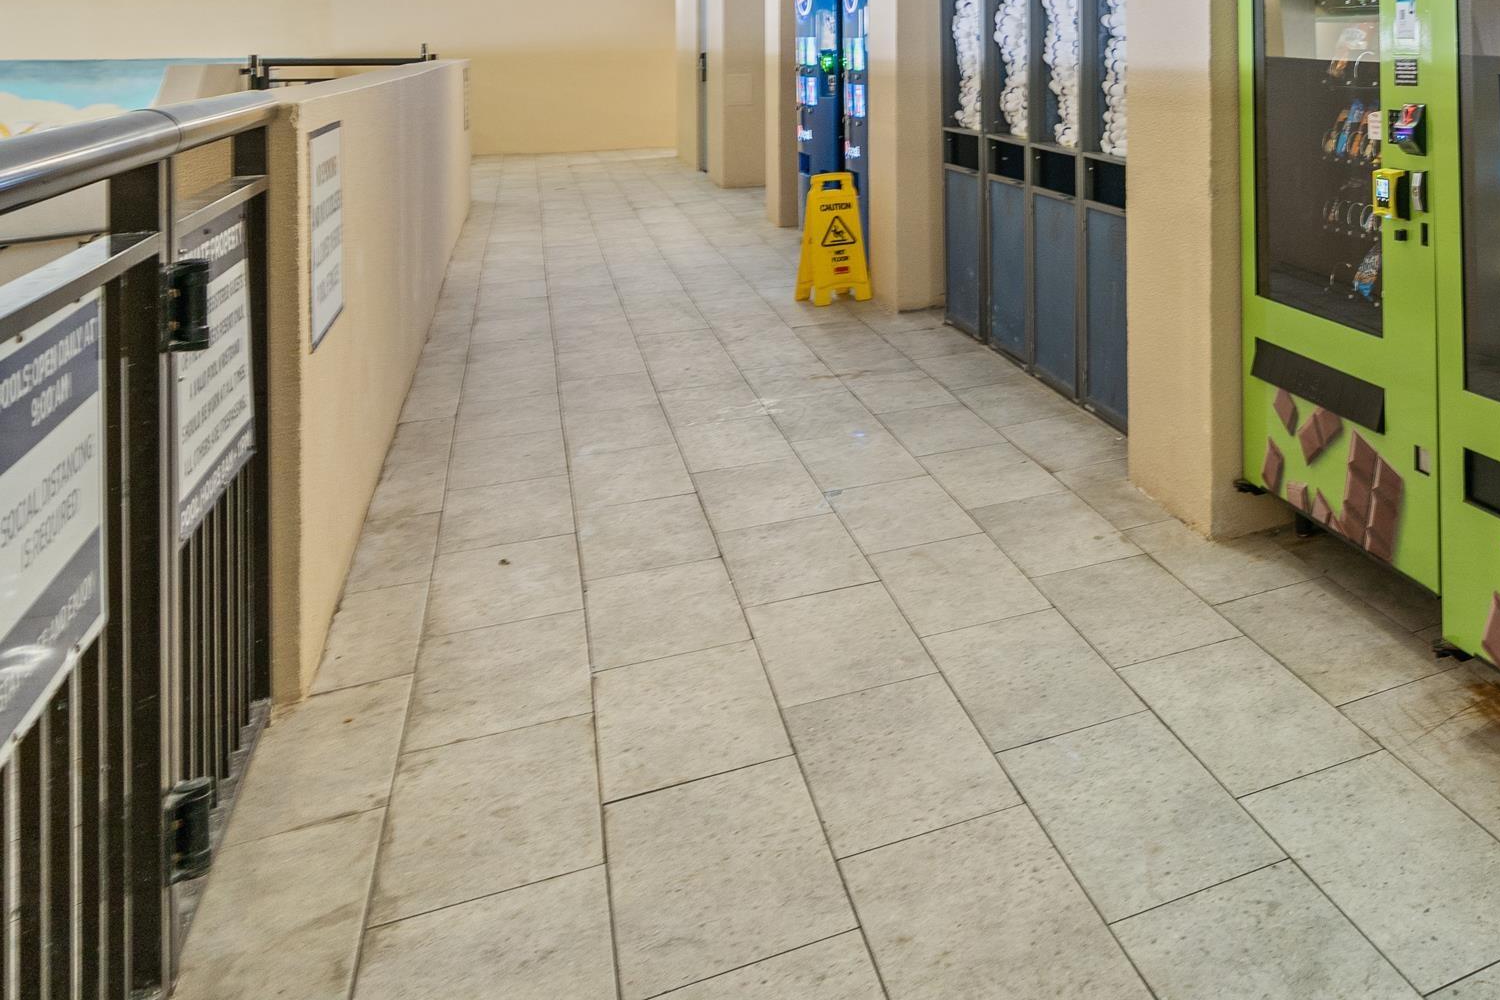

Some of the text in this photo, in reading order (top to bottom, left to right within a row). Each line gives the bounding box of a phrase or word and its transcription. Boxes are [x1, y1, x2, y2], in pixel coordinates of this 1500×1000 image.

[820, 202, 851, 211] CAUTION
[32, 344, 57, 387] OPEN
[59, 325, 83, 367] DAILY
[84, 316, 97, 348] AT
[1, 433, 92, 548] SOCIAL DISTANCING
[34, 488, 79, 557] REQUIRED
